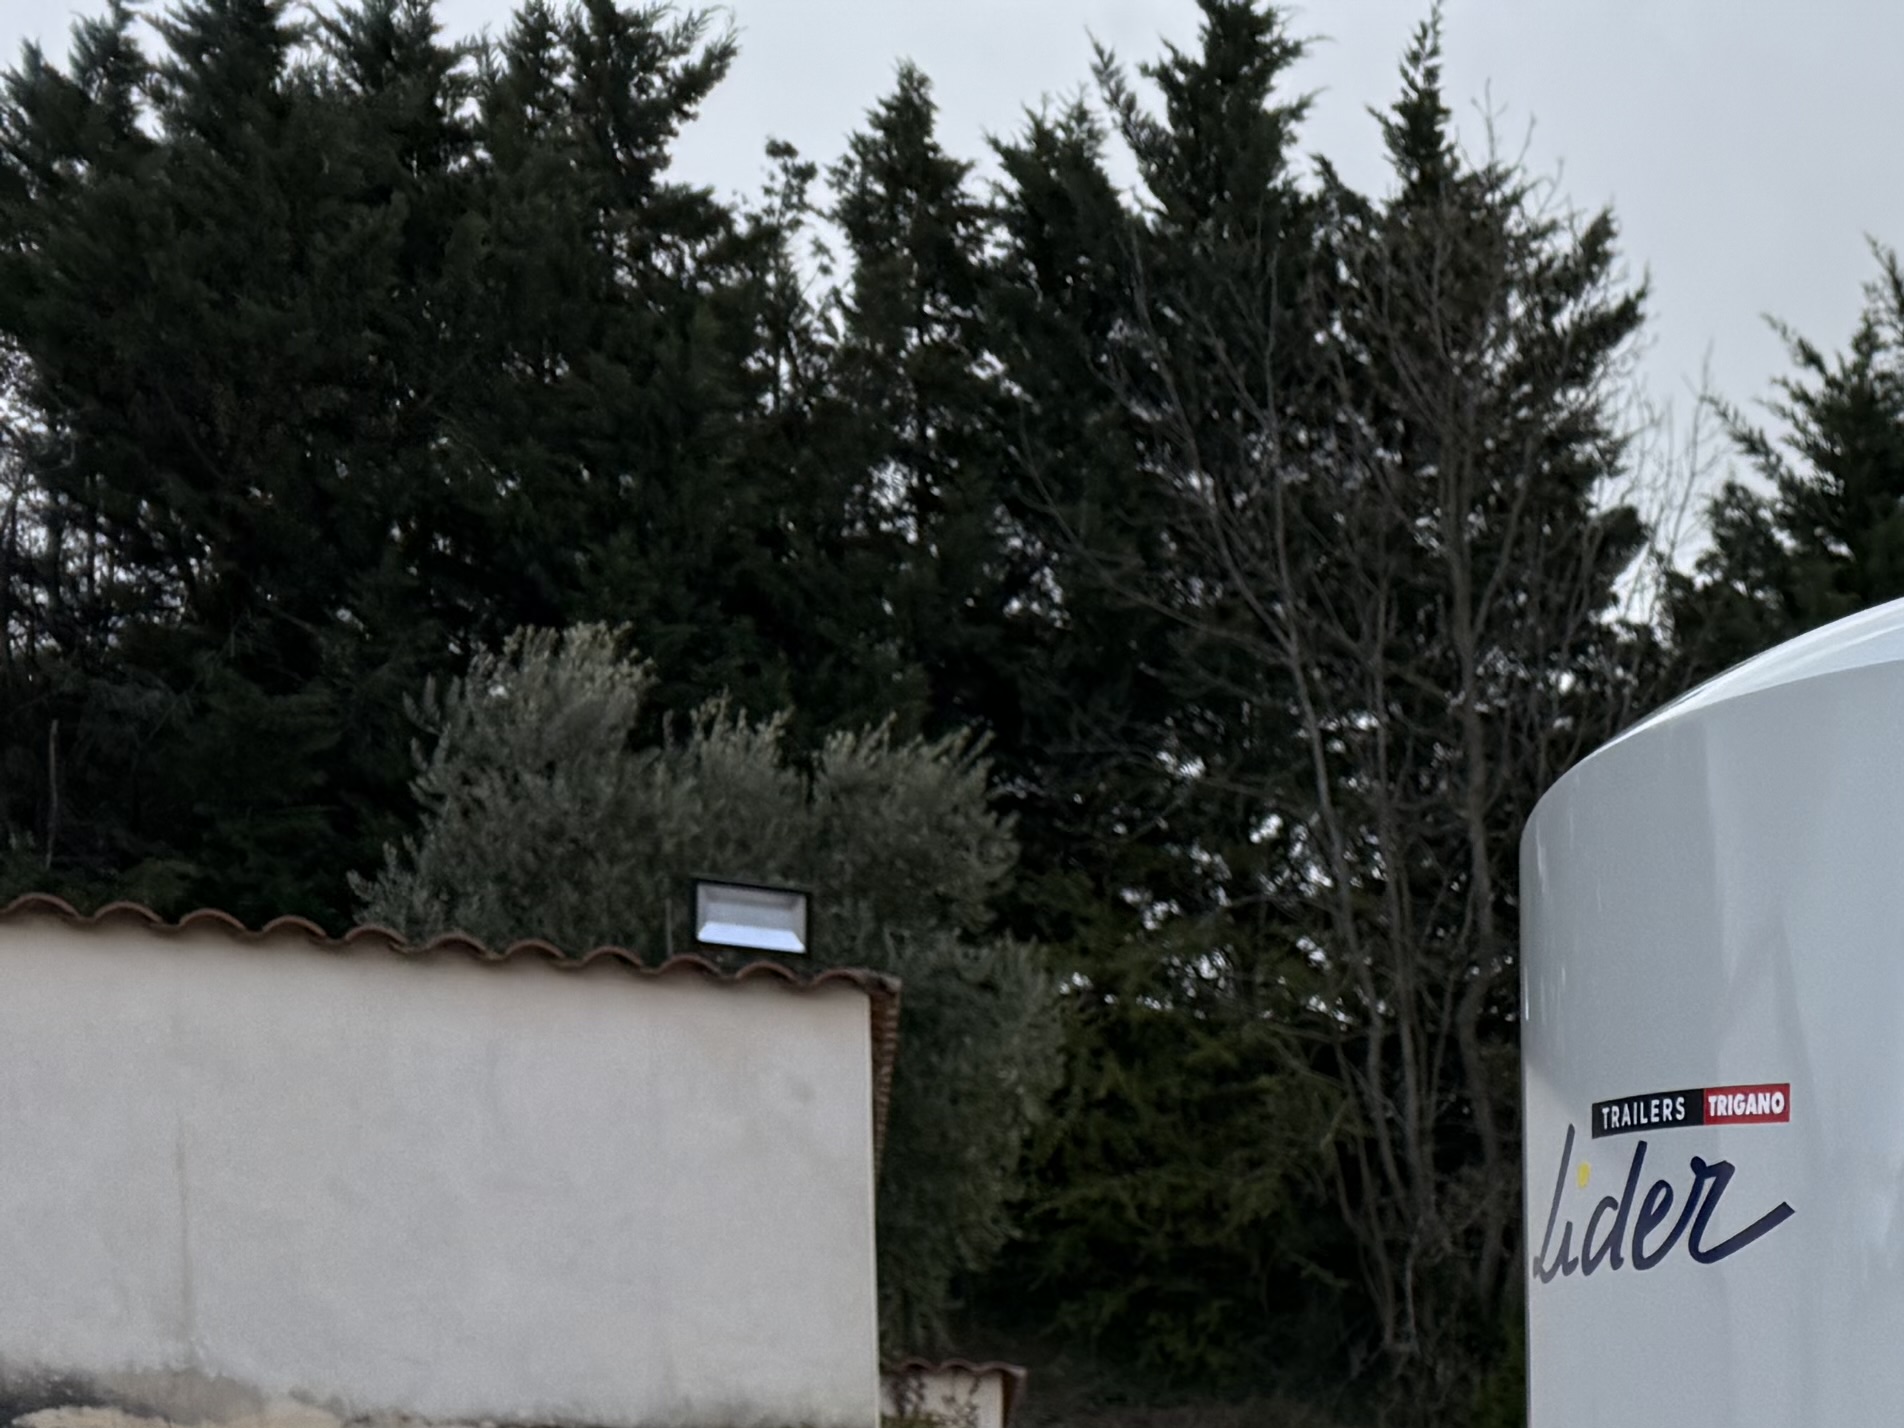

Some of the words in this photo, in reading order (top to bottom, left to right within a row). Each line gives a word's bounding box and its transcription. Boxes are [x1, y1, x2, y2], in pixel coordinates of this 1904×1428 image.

[1601, 1096, 1686, 1130] TRAILERS
[1707, 1091, 1785, 1117] TRIGANO
[1532, 1123, 1796, 1285] Lider
